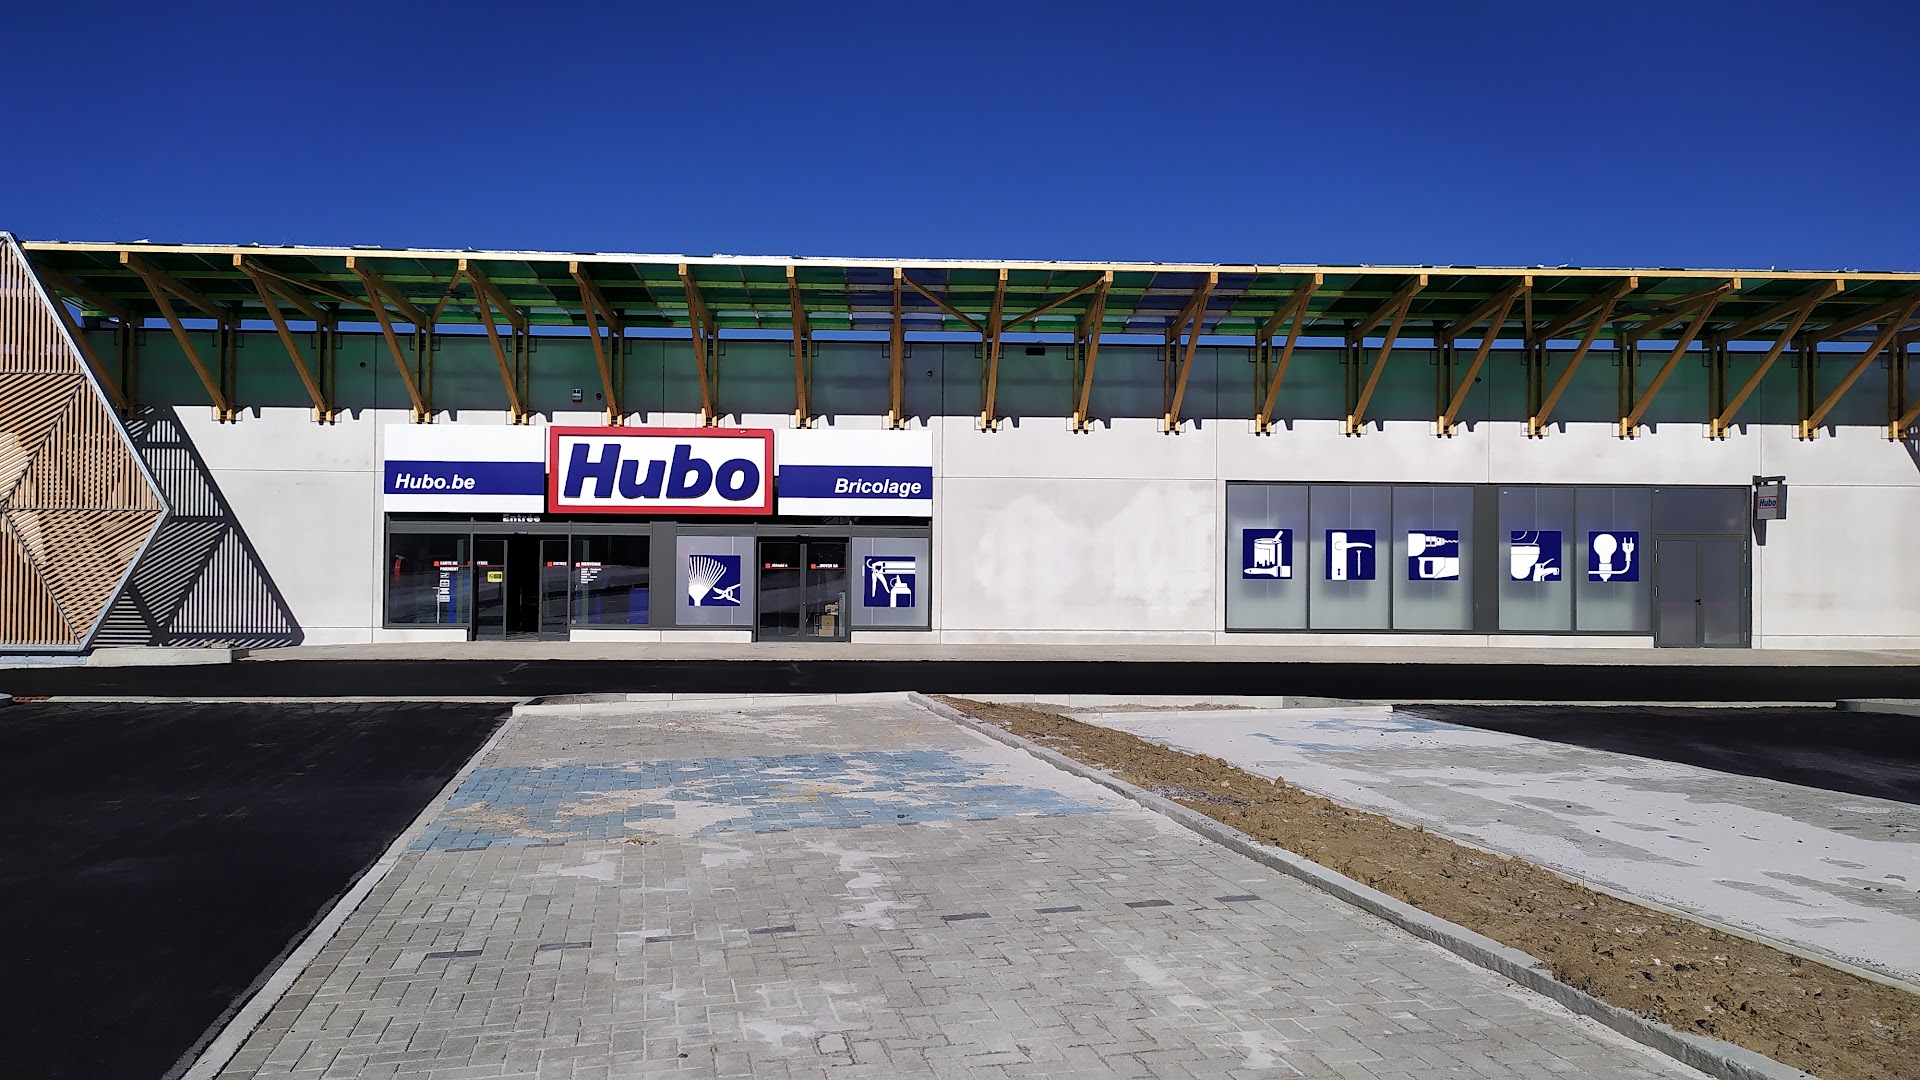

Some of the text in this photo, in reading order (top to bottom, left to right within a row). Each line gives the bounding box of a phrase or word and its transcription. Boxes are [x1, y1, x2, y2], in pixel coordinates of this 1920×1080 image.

[563, 443, 760, 501] Hubo
[395, 473, 475, 489] Hubo.be
[834, 478, 922, 497] Bricolage
[503, 514, 541, 522] Entrée
